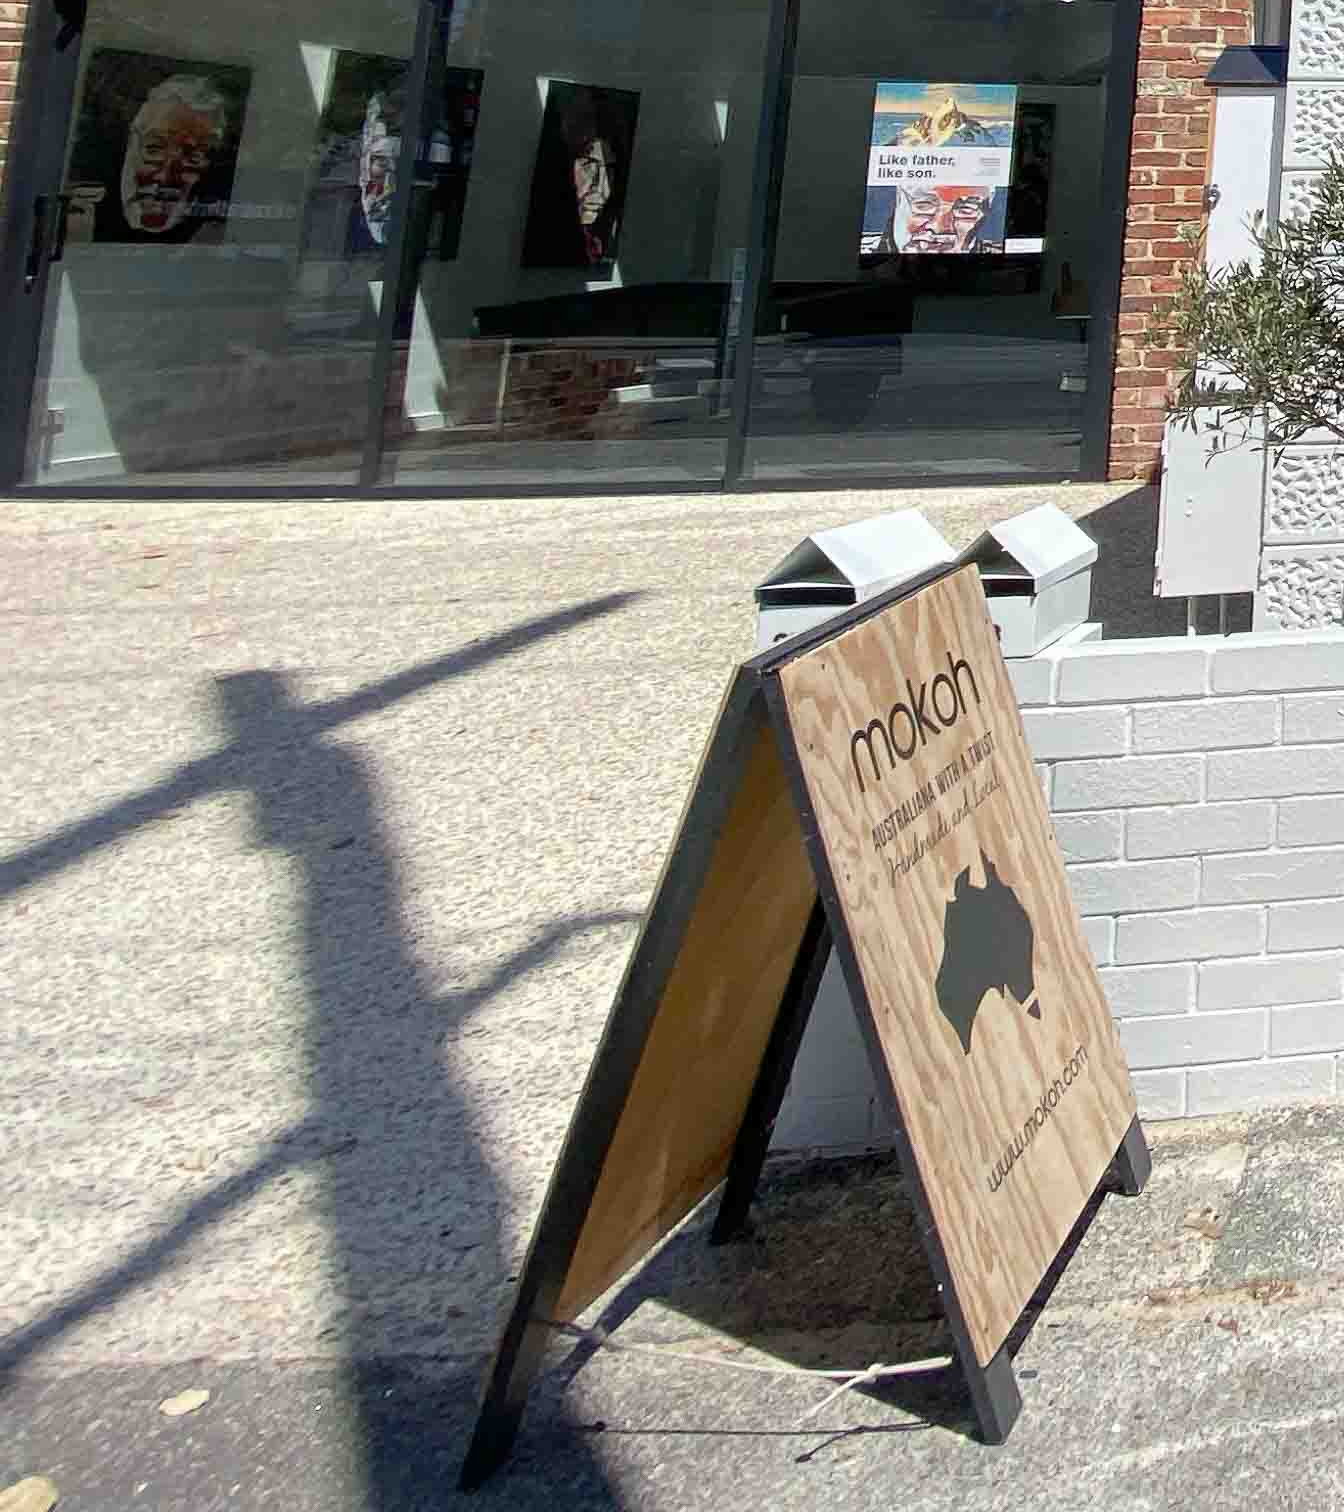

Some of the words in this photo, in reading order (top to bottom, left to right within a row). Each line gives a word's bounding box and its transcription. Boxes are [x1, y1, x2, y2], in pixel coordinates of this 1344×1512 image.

[878, 168, 903, 178] like
[879, 155, 908, 165] Like
[848, 650, 982, 793] mokoh
[872, 781, 937, 853] AUSTRALIANA
[935, 761, 961, 796] WITH
[960, 753, 970, 775] A
[986, 1046, 1088, 1193] www.mokoh.com
